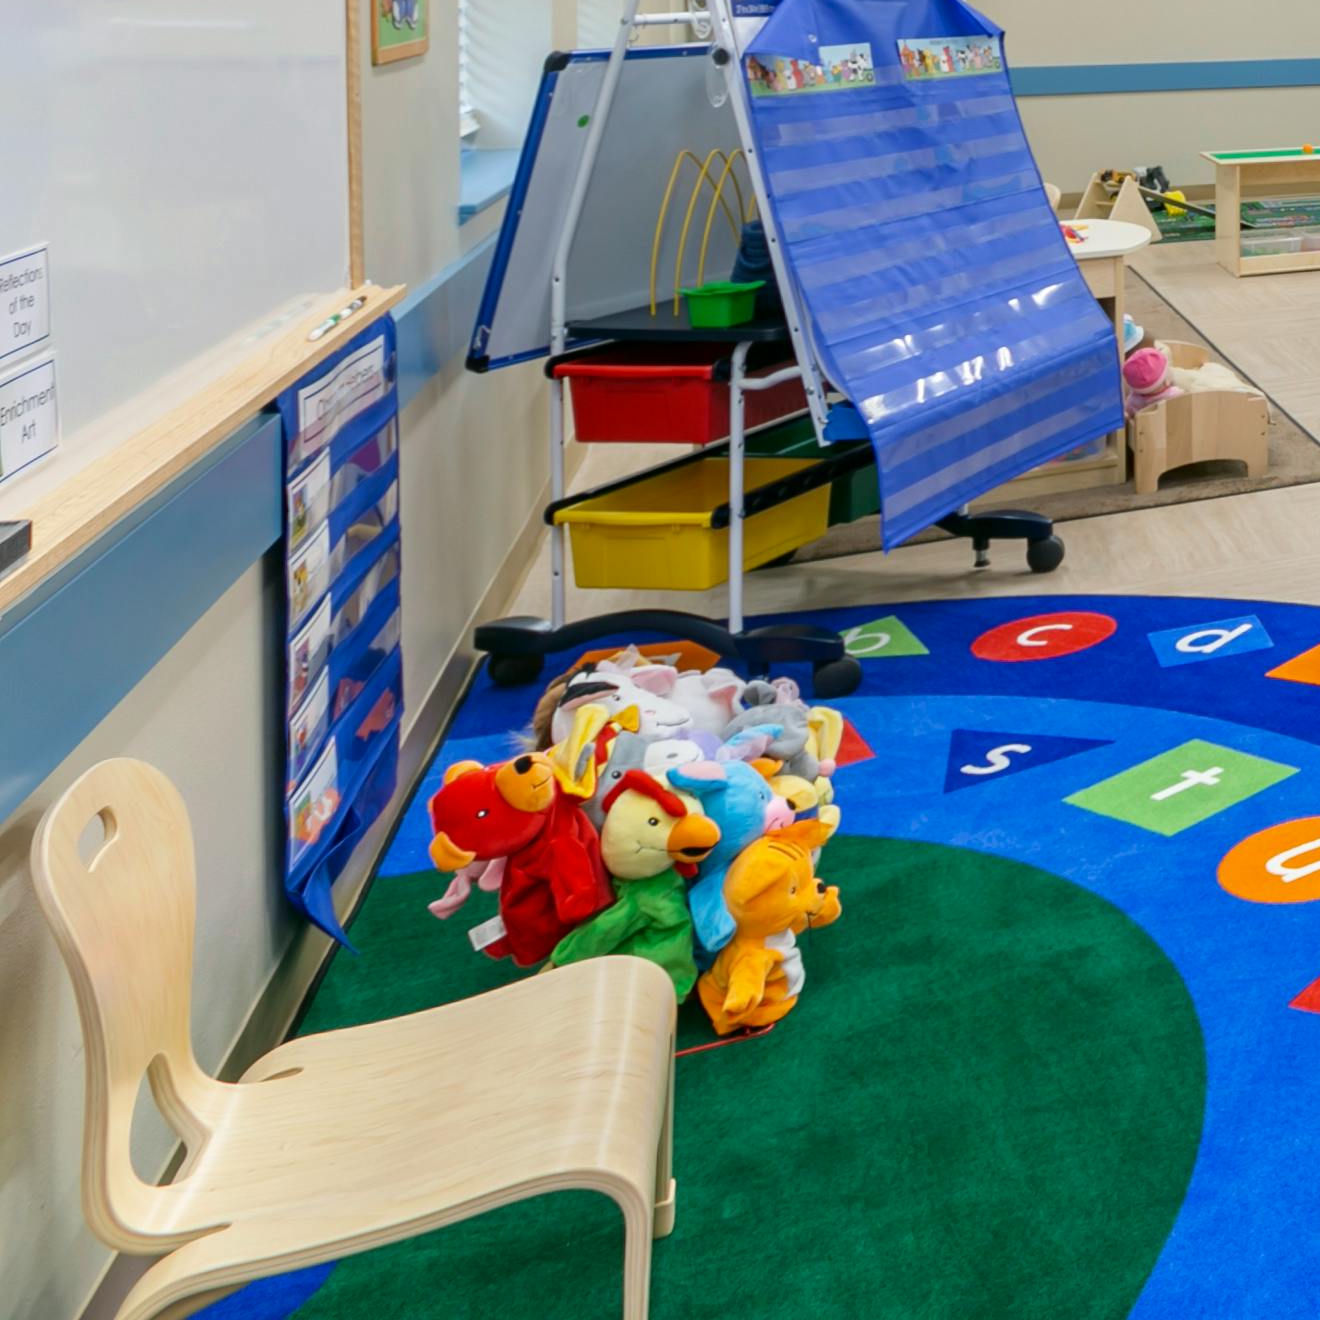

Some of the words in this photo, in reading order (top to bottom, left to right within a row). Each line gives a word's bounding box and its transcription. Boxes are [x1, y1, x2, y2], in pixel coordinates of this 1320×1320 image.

[19, 293, 34, 311] the
[13, 320, 32, 339] Day
[21, 419, 36, 444] Art
[1016, 623, 1073, 647] c
[1175, 623, 1253, 654] d
[960, 742, 1032, 776] s
[1150, 765, 1225, 801] t
